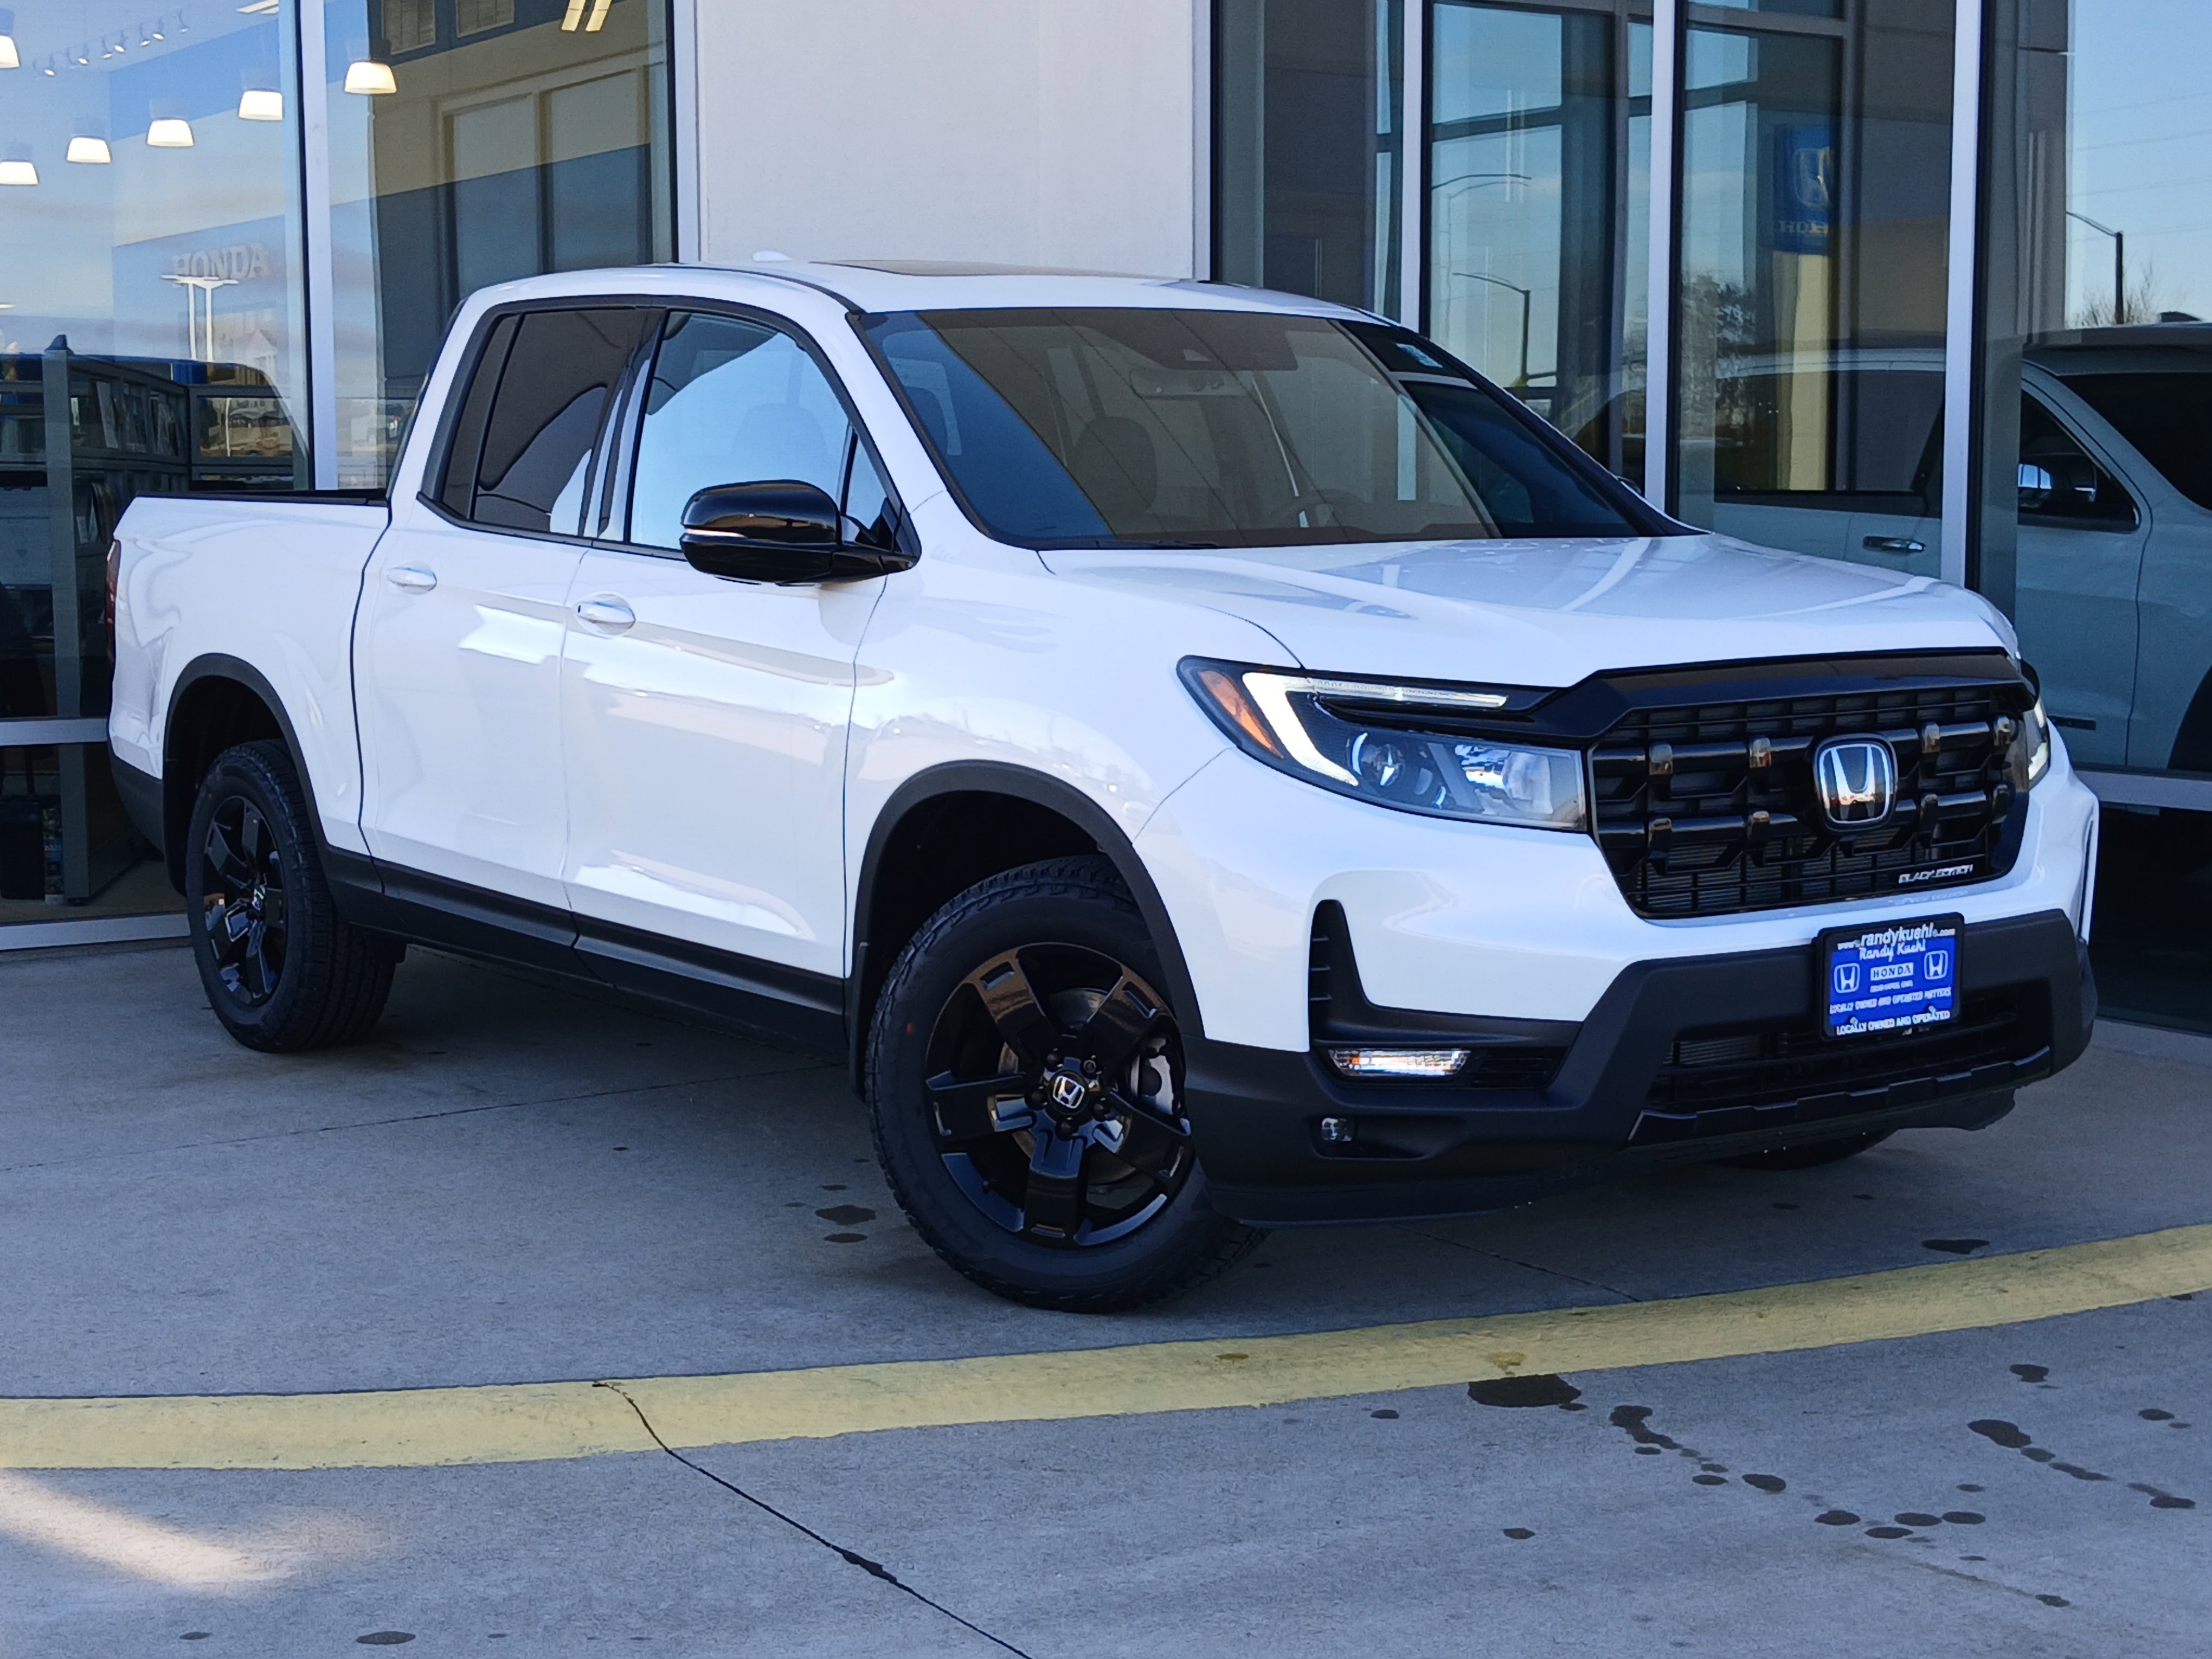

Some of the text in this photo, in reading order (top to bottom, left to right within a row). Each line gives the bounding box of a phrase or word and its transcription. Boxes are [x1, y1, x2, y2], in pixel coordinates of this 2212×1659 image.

[171, 243, 271, 282] HONDA
[1859, 939, 1926, 962] Randy Kuehl
[1873, 964, 1912, 978] HONDA
[1896, 1015, 1912, 1026] AND
